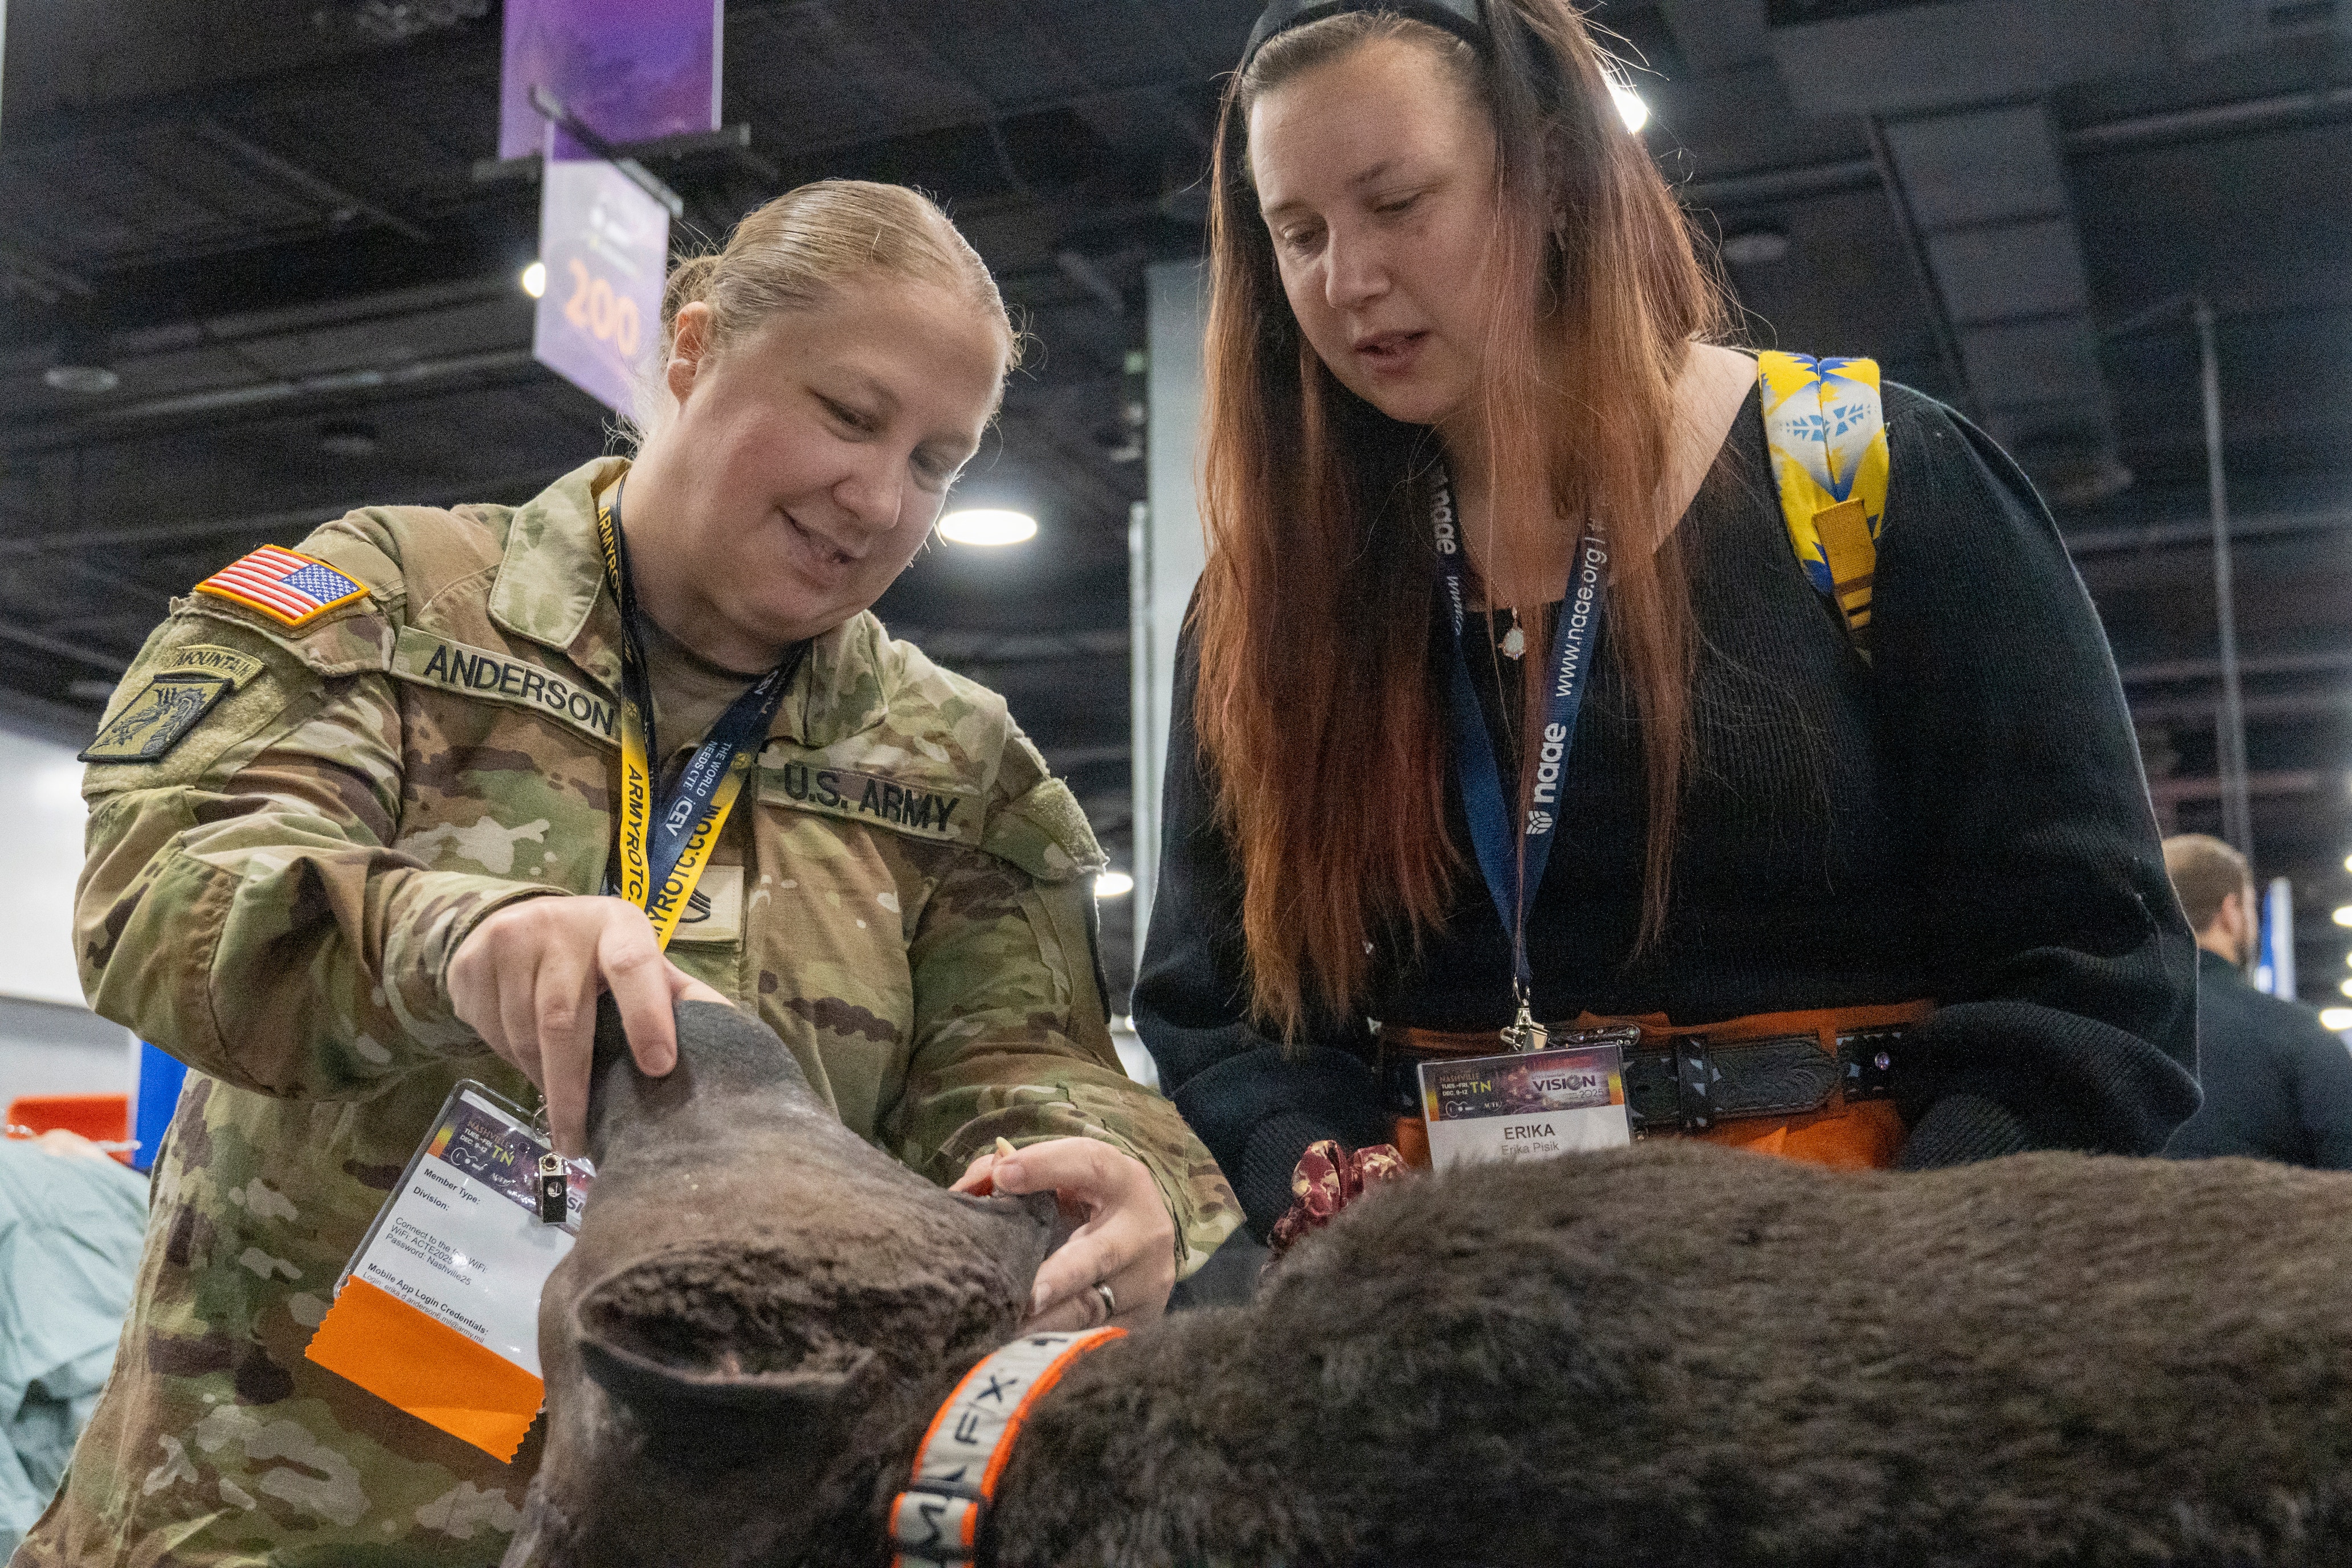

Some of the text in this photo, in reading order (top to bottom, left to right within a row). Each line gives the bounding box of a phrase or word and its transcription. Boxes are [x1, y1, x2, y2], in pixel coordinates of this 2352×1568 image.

[564, 258, 640, 357] 200
[1434, 489, 1456, 554] naae
[423, 644, 615, 736] ANDERSON
[1534, 723, 1566, 803] naae
[1555, 549, 1607, 697] www.naae.org
[683, 741, 718, 791] NEEDS CTE
[696, 742, 732, 797] THE WORLD
[783, 763, 959, 832] U.S. ARMY
[1469, 1080, 1492, 1093] TN
[1579, 1088, 1604, 1099] 2025
[492, 1144, 515, 1167] TN
[1501, 1141, 1559, 1155] Erika Pisik
[1504, 1124, 1555, 1140] ERIKA
[413, 1186, 450, 1211] Division:
[424, 1168, 481, 1205] Member Type:
[385, 1233, 426, 1260] Password:
[427, 1256, 472, 1286] Nashville25
[391, 1224, 411, 1241] WiFi:
[411, 1237, 453, 1265] ACTE2025
[396, 1217, 488, 1274] Connect to the WiFi:
[368, 1262, 489, 1336] Mobile App Login Credentials:
